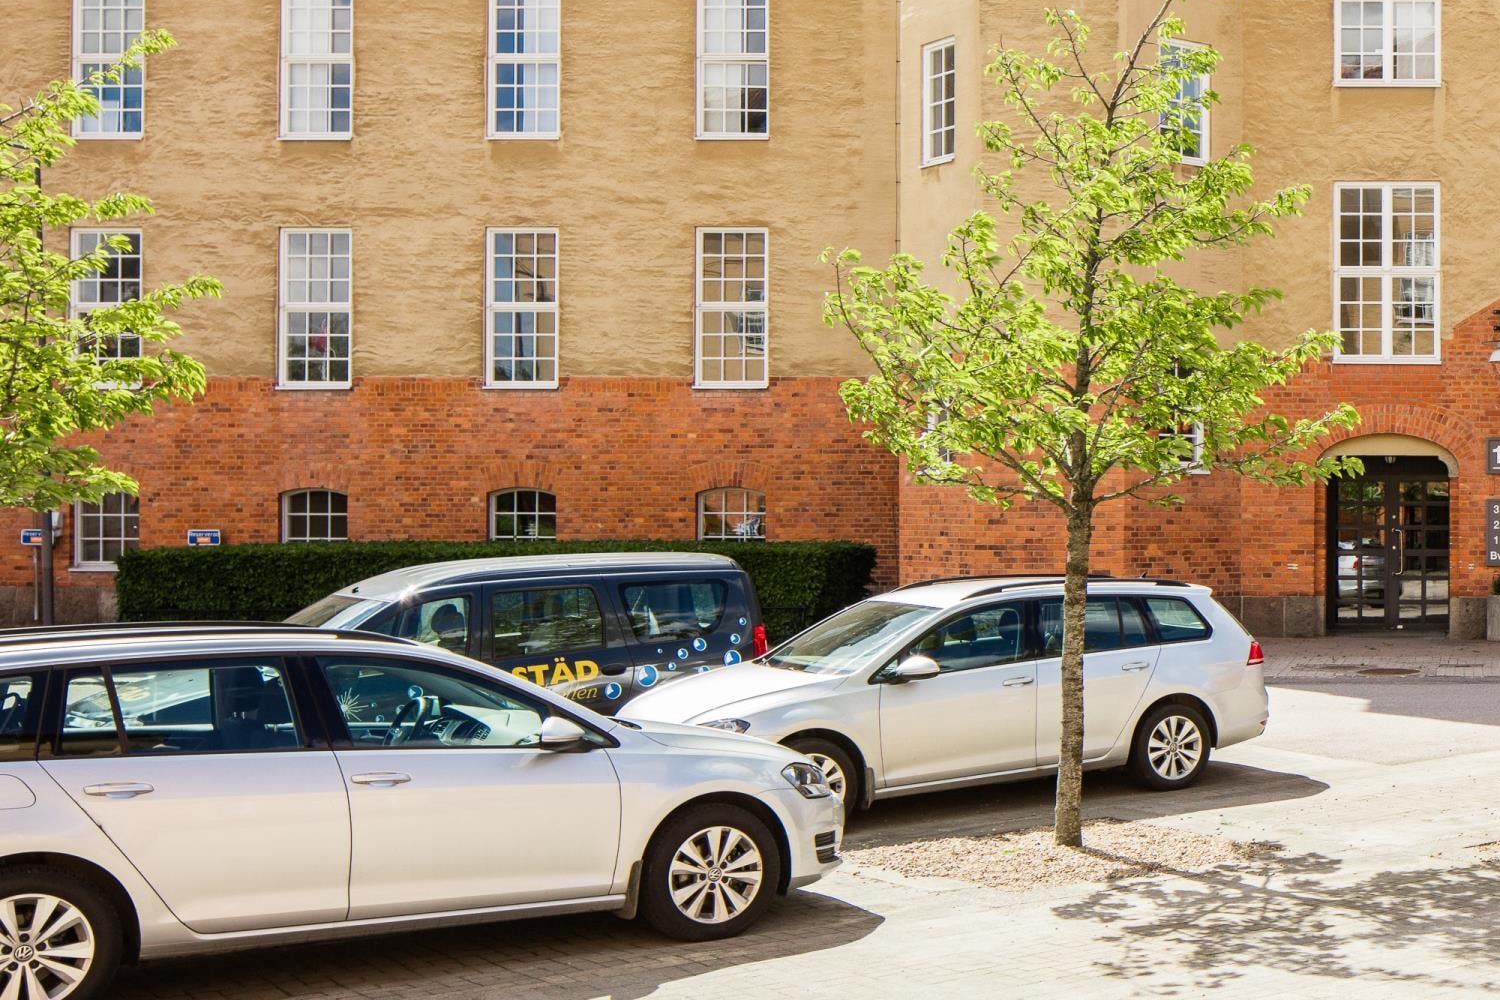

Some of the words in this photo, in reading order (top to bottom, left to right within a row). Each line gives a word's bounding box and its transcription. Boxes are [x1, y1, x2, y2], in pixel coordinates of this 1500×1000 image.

[1366, 486, 1382, 498] 12
[1493, 504, 1500, 514] 3
[1493, 520, 1500, 530] 2
[1493, 535, 1499, 545] 1
[511, 656, 599, 687] STÄD
